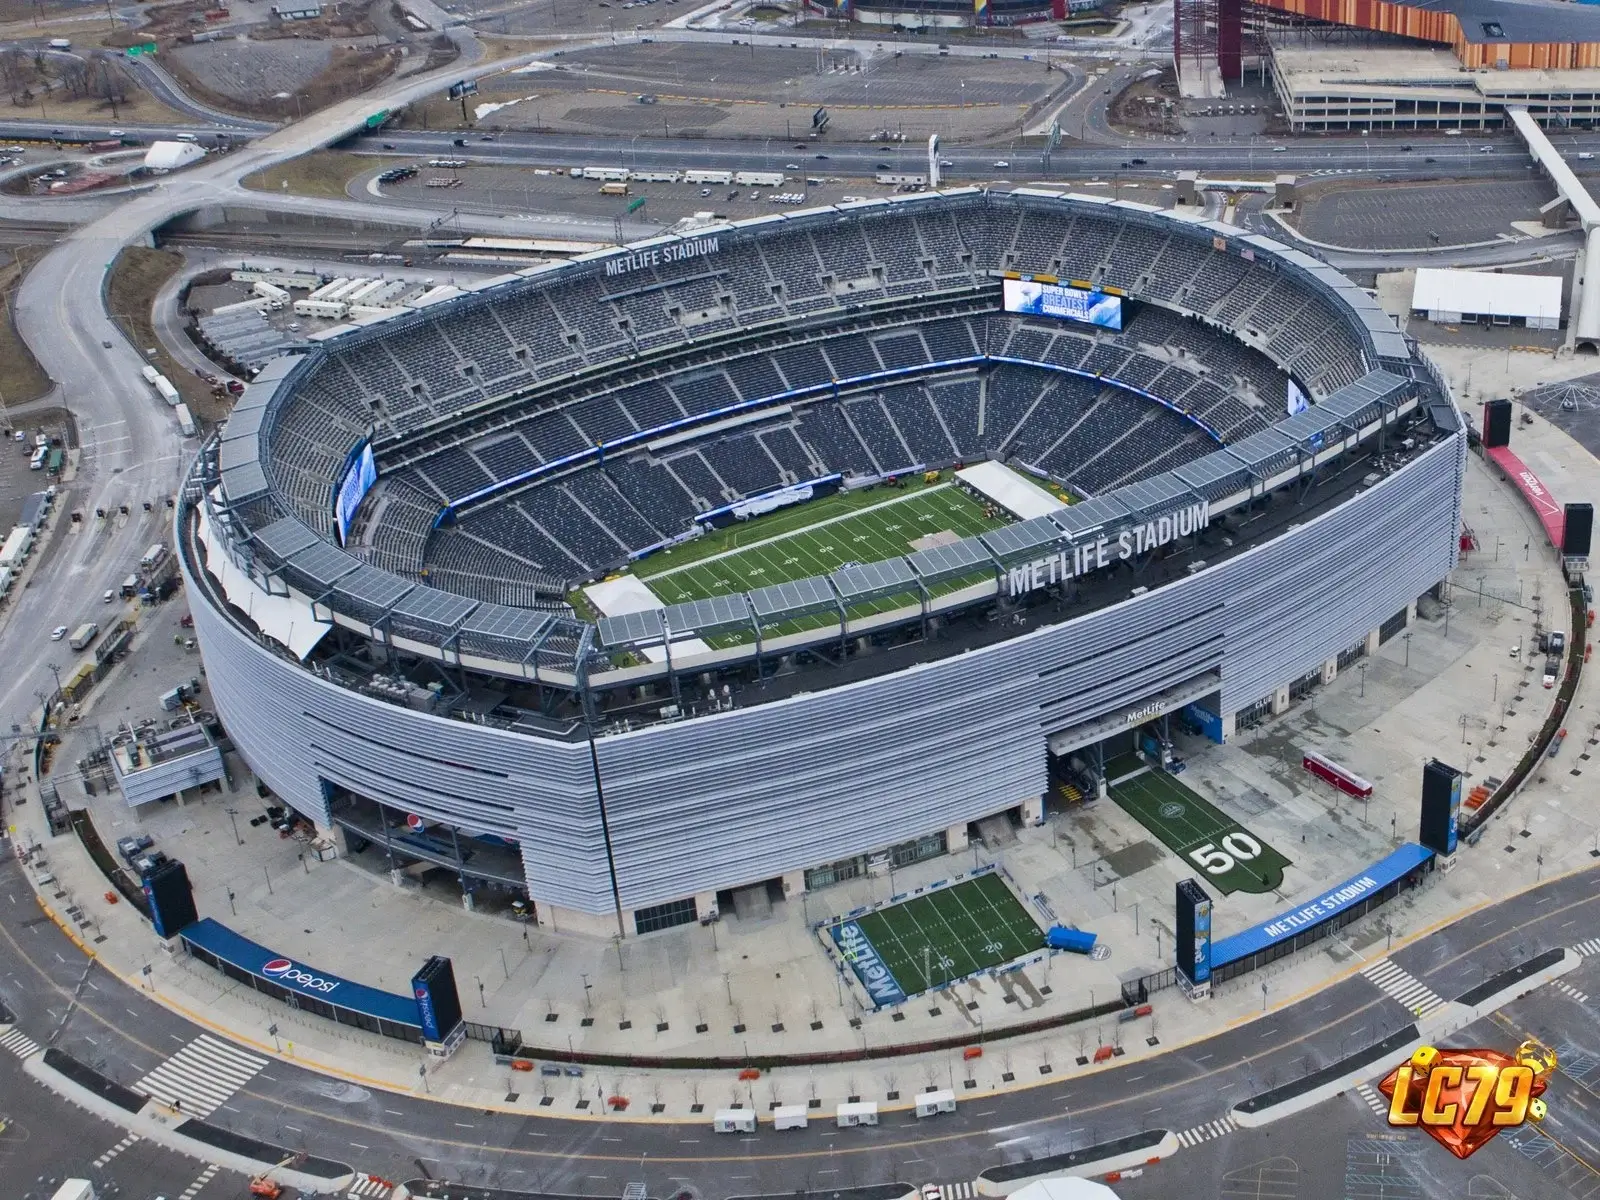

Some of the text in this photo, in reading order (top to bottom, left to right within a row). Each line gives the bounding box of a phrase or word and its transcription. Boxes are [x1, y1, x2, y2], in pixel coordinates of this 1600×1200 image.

[605, 237, 719, 277] METLIFE STADIUM
[1042, 285, 1064, 296] SUPER
[1042, 293, 1088, 311] GREATEST
[1042, 304, 1089, 320] COMMERCIALS
[1009, 500, 1209, 597] METLIFE STADIUM
[1127, 701, 1166, 722] MetLife
[1255, 694, 1273, 709] CLUB
[1189, 832, 1262, 875] 50
[1263, 876, 1377, 937] METLIFE STADIUM
[985, 941, 1003, 954] 20
[839, 925, 900, 998] MetLife
[280, 969, 340, 993] pepsi
